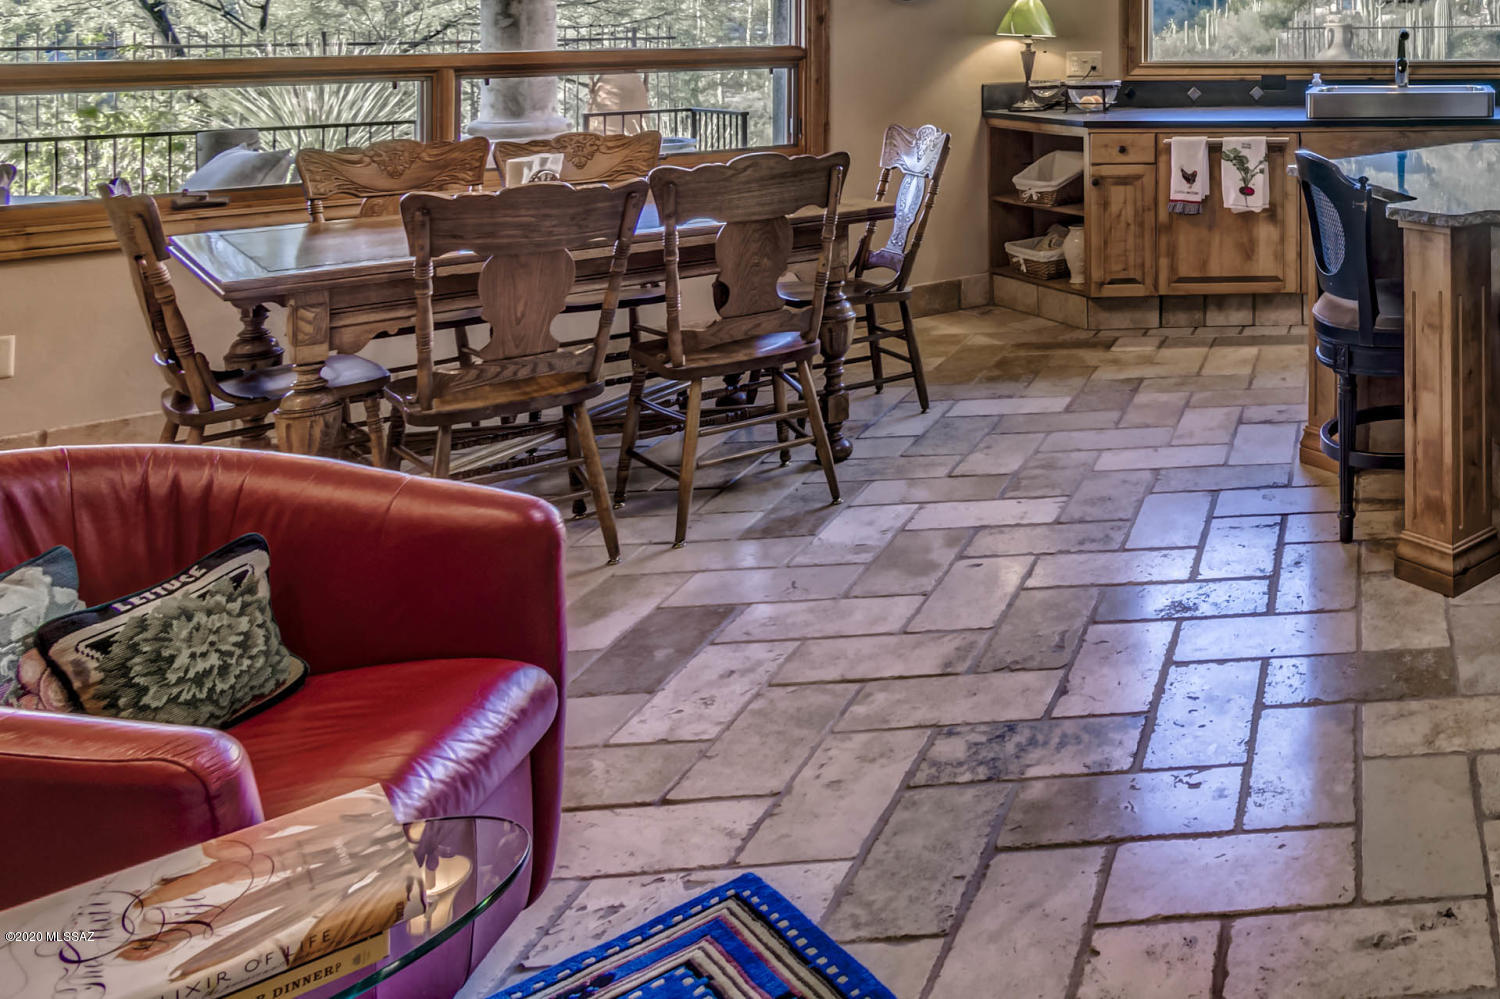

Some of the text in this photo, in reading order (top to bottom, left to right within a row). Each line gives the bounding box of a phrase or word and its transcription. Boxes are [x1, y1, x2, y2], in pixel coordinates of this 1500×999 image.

[110, 564, 207, 613] LETTUCE
[244, 951, 274, 973] OF
[285, 928, 332, 959] LIFE
[272, 962, 342, 999] DINNER?
